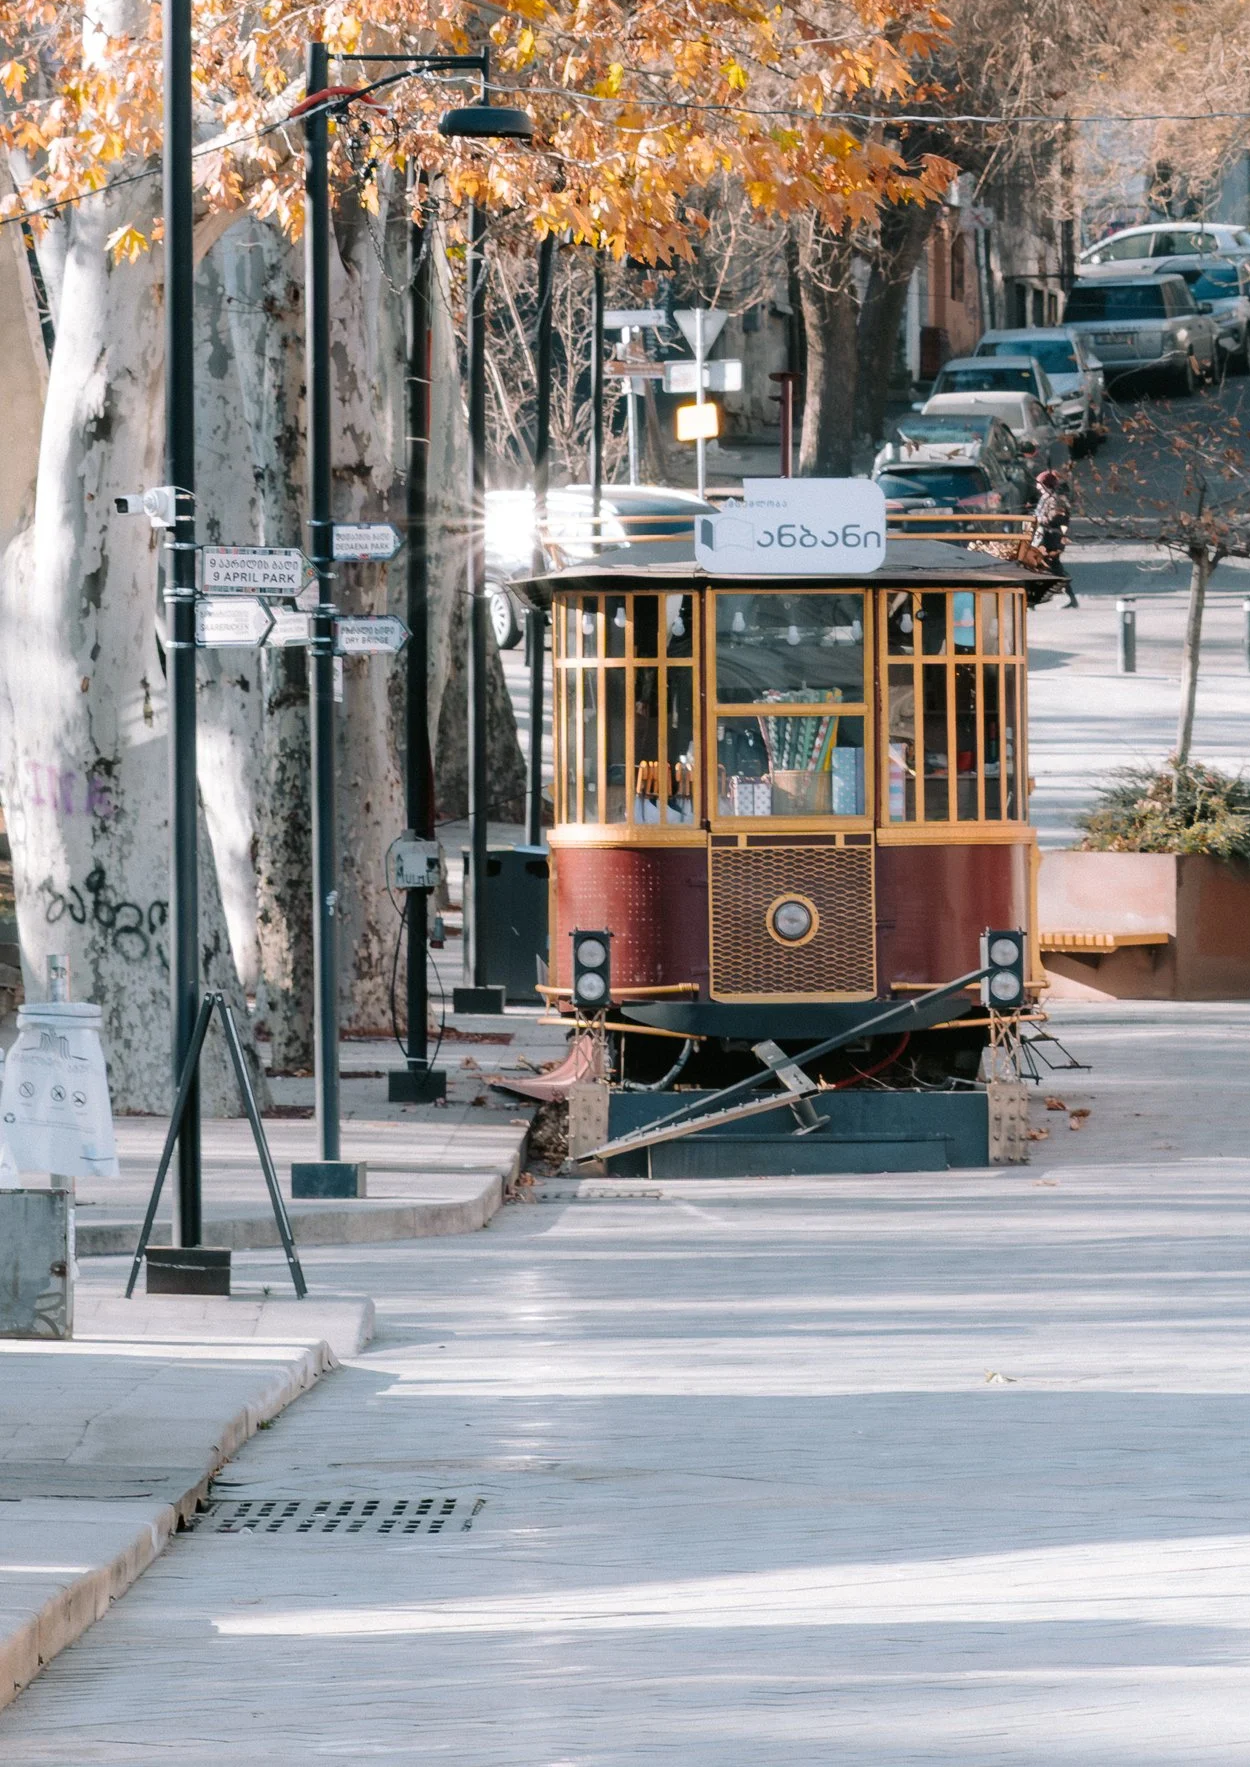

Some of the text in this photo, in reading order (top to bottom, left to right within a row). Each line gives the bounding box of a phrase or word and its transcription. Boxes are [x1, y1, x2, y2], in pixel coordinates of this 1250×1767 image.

[756, 524, 881, 548] ანბანი
[336, 542, 390, 550] DEDAENA PARK
[209, 558, 217, 568] 9
[213, 571, 296, 584] 9 APRIL PARK
[345, 636, 389, 644] DRY BRIDGE
